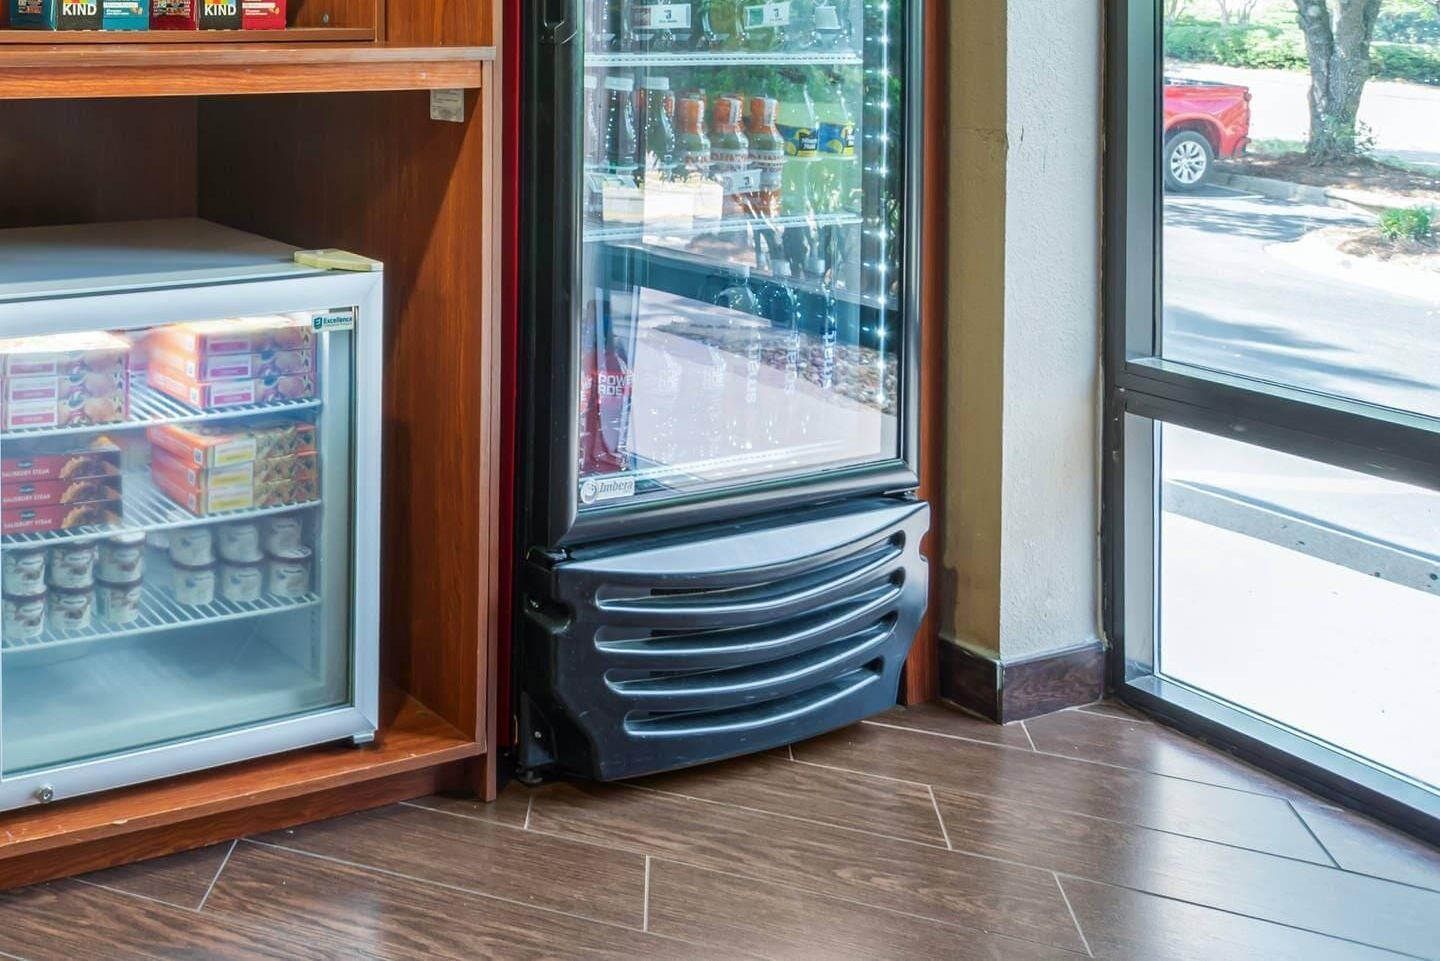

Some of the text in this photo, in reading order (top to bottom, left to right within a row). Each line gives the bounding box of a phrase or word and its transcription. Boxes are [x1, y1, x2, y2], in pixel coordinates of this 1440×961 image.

[62, 3, 97, 17] KIND
[204, 4, 237, 17] KIND
[599, 480, 633, 493] Imbera
[34, 518, 52, 526] STEAK
